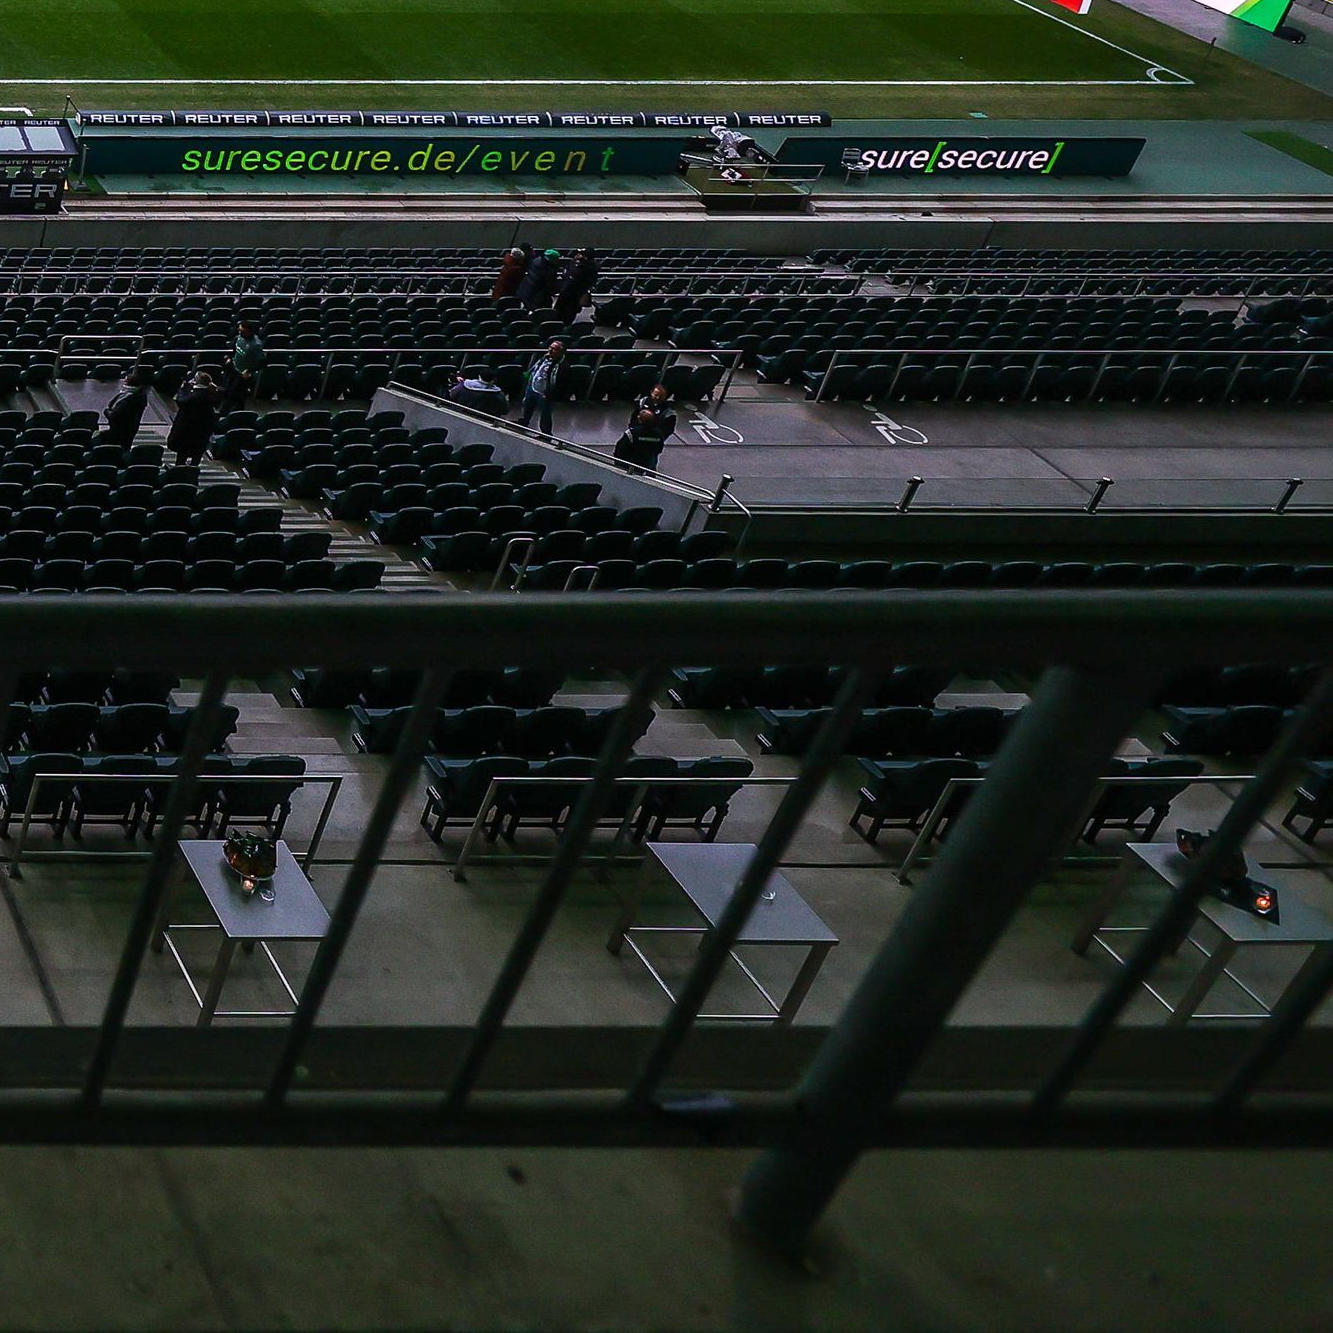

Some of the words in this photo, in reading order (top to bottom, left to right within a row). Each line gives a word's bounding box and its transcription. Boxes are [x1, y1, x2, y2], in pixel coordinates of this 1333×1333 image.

[90, 113, 165, 125] REUTER
[465, 114, 541, 126] REUTER
[654, 115, 728, 127] REUTER
[747, 115, 822, 127] REUTER
[860, 140, 1065, 174] sure[secure]
